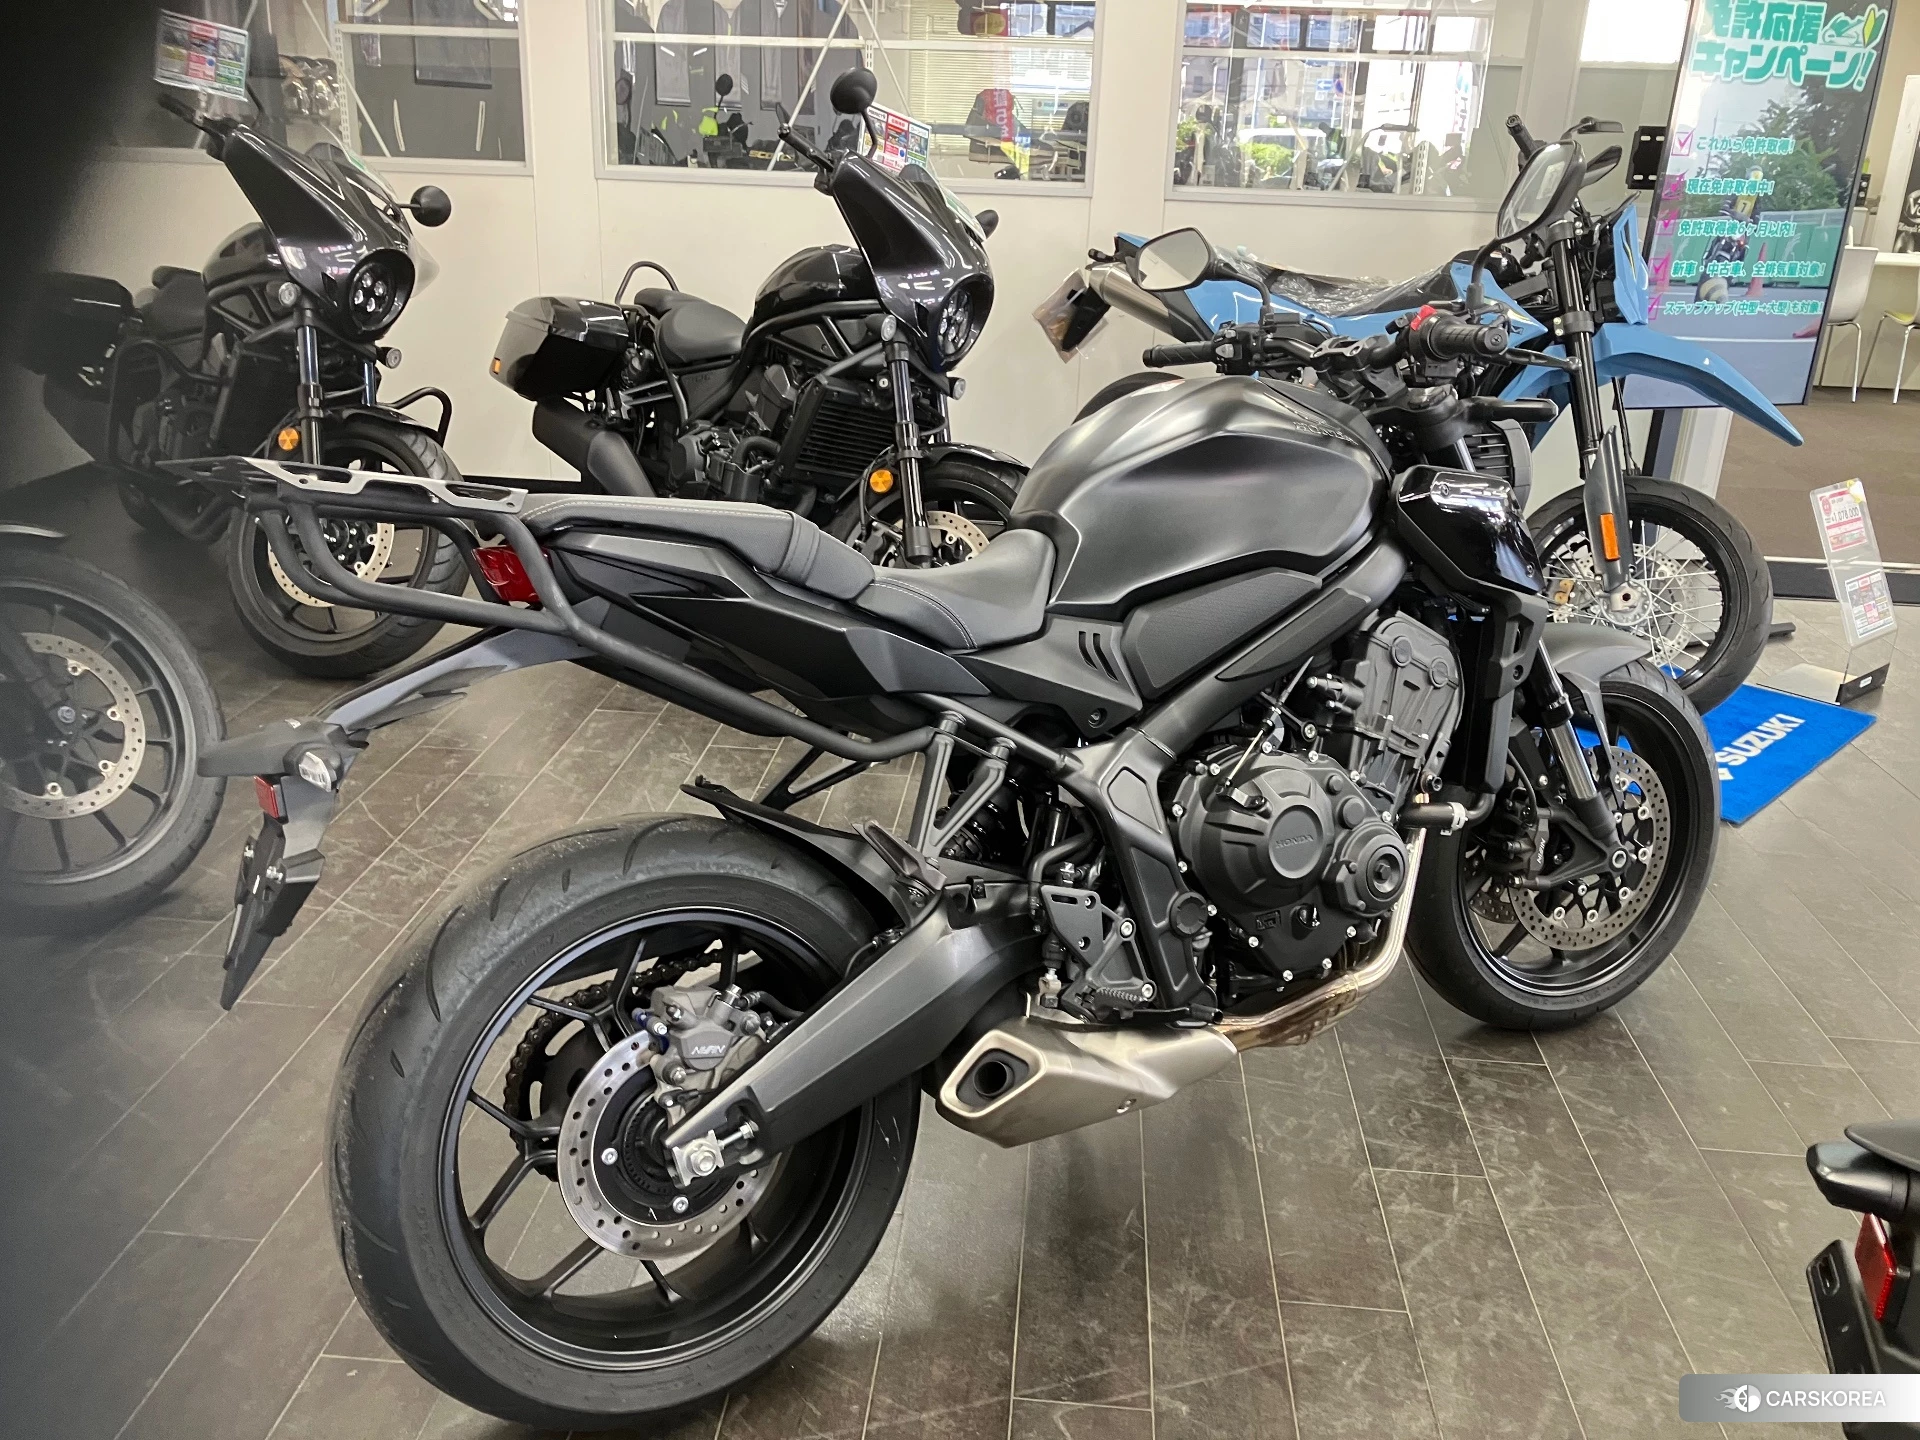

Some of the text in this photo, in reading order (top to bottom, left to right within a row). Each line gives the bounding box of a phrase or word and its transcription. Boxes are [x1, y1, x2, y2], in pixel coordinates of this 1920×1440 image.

[1696, 136, 1795, 155] これから免許取得!
[1686, 177, 1775, 196] 現在免許取得中!
[1714, 713, 1806, 766] SUZUKI
[1275, 834, 1314, 849] HONDA
